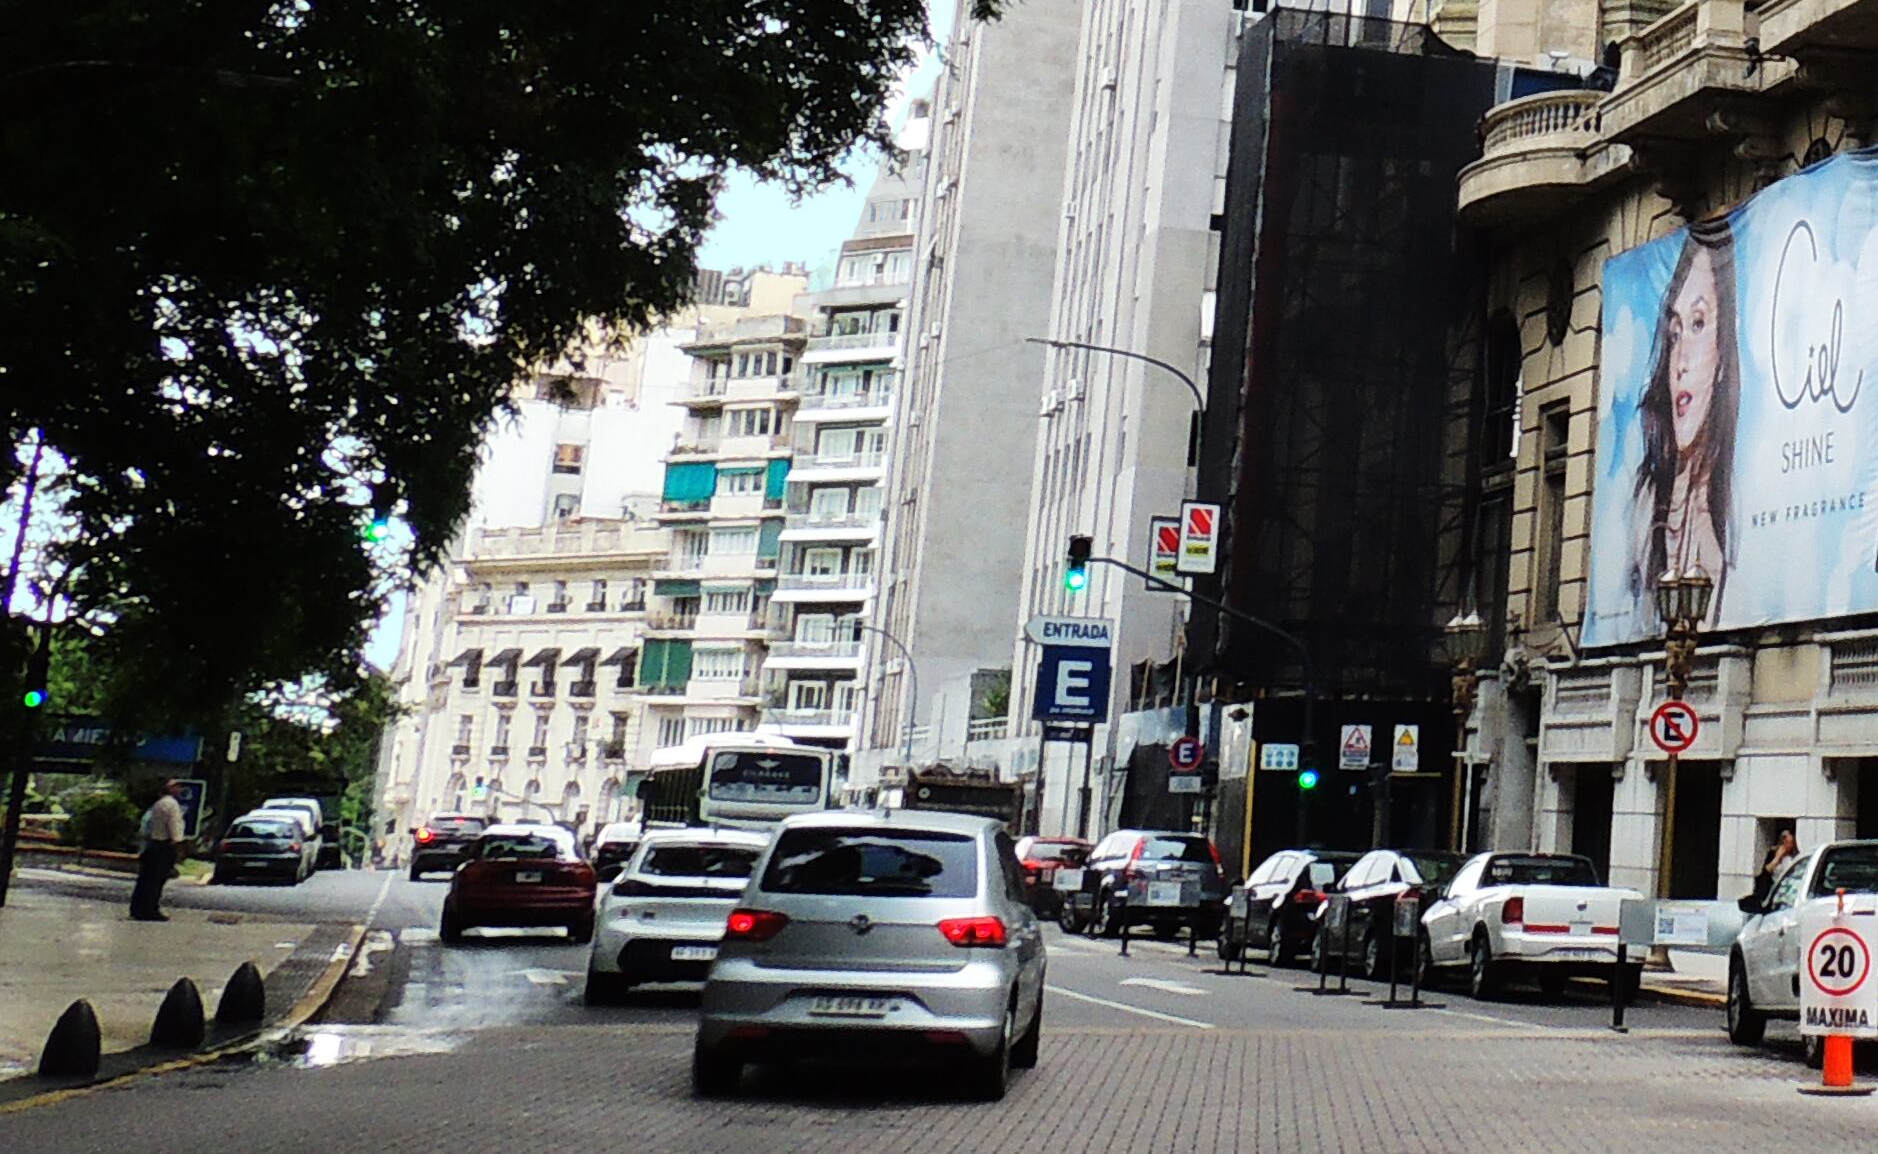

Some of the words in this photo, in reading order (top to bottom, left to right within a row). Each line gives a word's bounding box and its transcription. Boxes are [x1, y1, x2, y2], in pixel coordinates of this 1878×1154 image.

[1771, 219, 1863, 414] Ciel
[1781, 431, 1835, 474] SHINE
[1752, 509, 1778, 527] NEW
[1785, 491, 1866, 521] FRAGRANCE
[1043, 621, 1108, 639] ENTRADA
[1055, 659, 1093, 706] E
[1178, 743, 1193, 763] E
[1820, 944, 1855, 978] 20
[1806, 1007, 1868, 1028] MAXIMA
